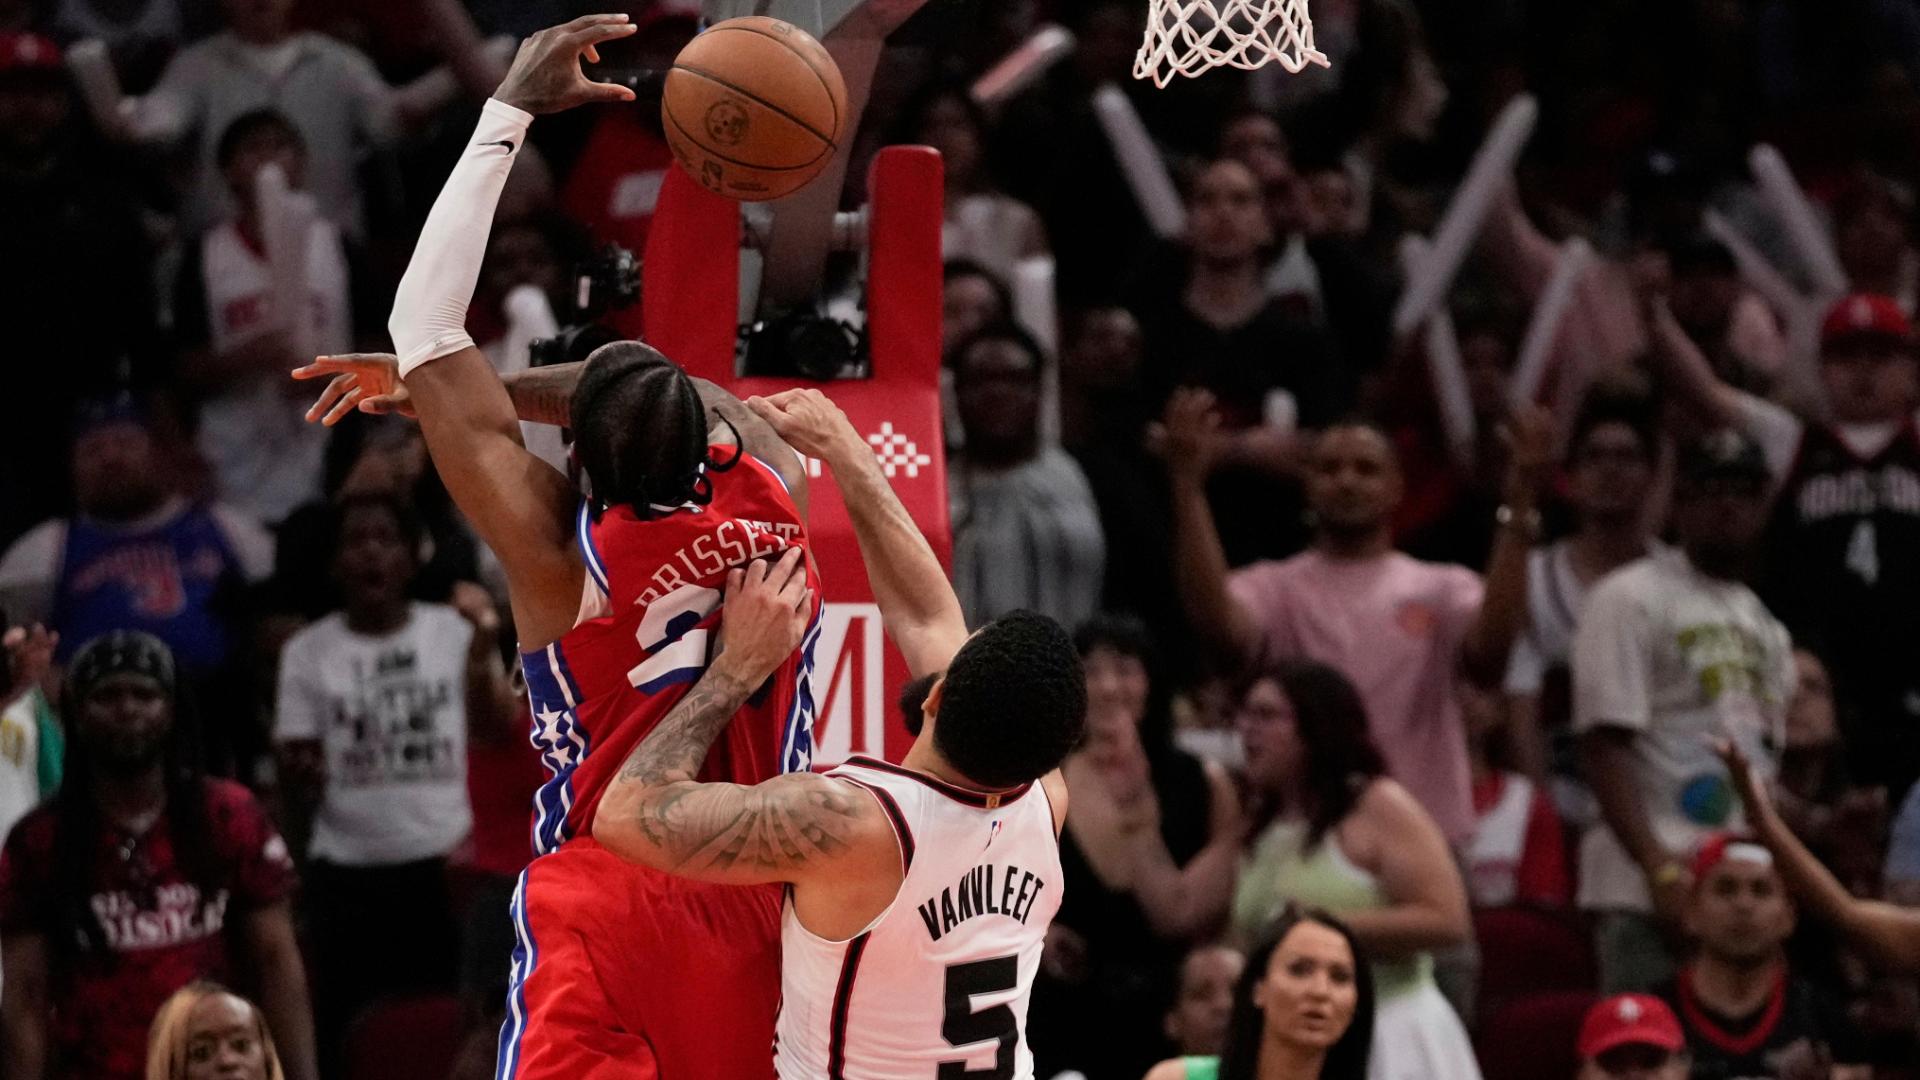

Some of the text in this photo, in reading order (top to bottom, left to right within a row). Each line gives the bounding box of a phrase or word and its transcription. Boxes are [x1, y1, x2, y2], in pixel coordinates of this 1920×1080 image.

[627, 583, 757, 702] 2
[917, 863, 1045, 942] VANVLEET
[936, 951, 1020, 1080] 5
